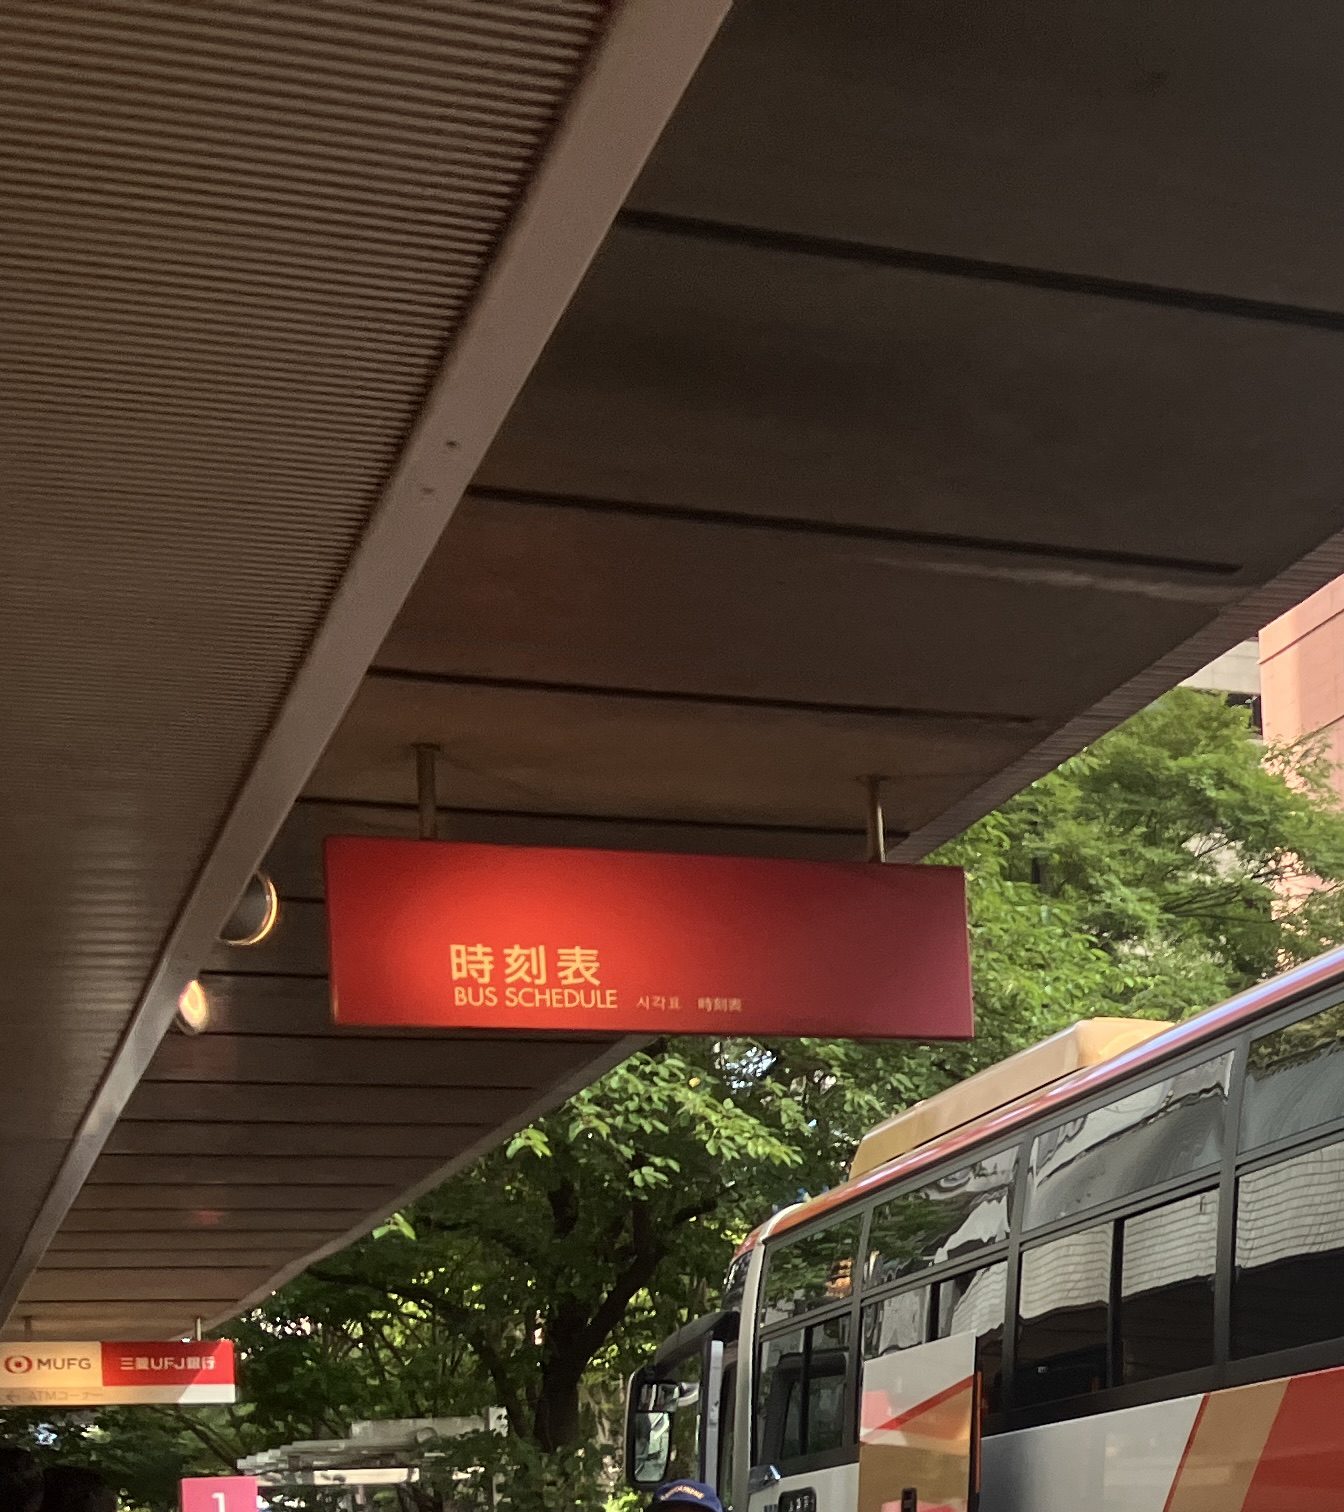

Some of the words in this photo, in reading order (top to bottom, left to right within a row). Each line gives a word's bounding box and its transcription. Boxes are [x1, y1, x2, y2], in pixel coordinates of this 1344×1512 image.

[450, 944, 601, 987] 時刻表
[454, 987, 498, 1007] BUS
[505, 988, 618, 1009] SCHEDULE
[37, 1357, 92, 1371] MUFG
